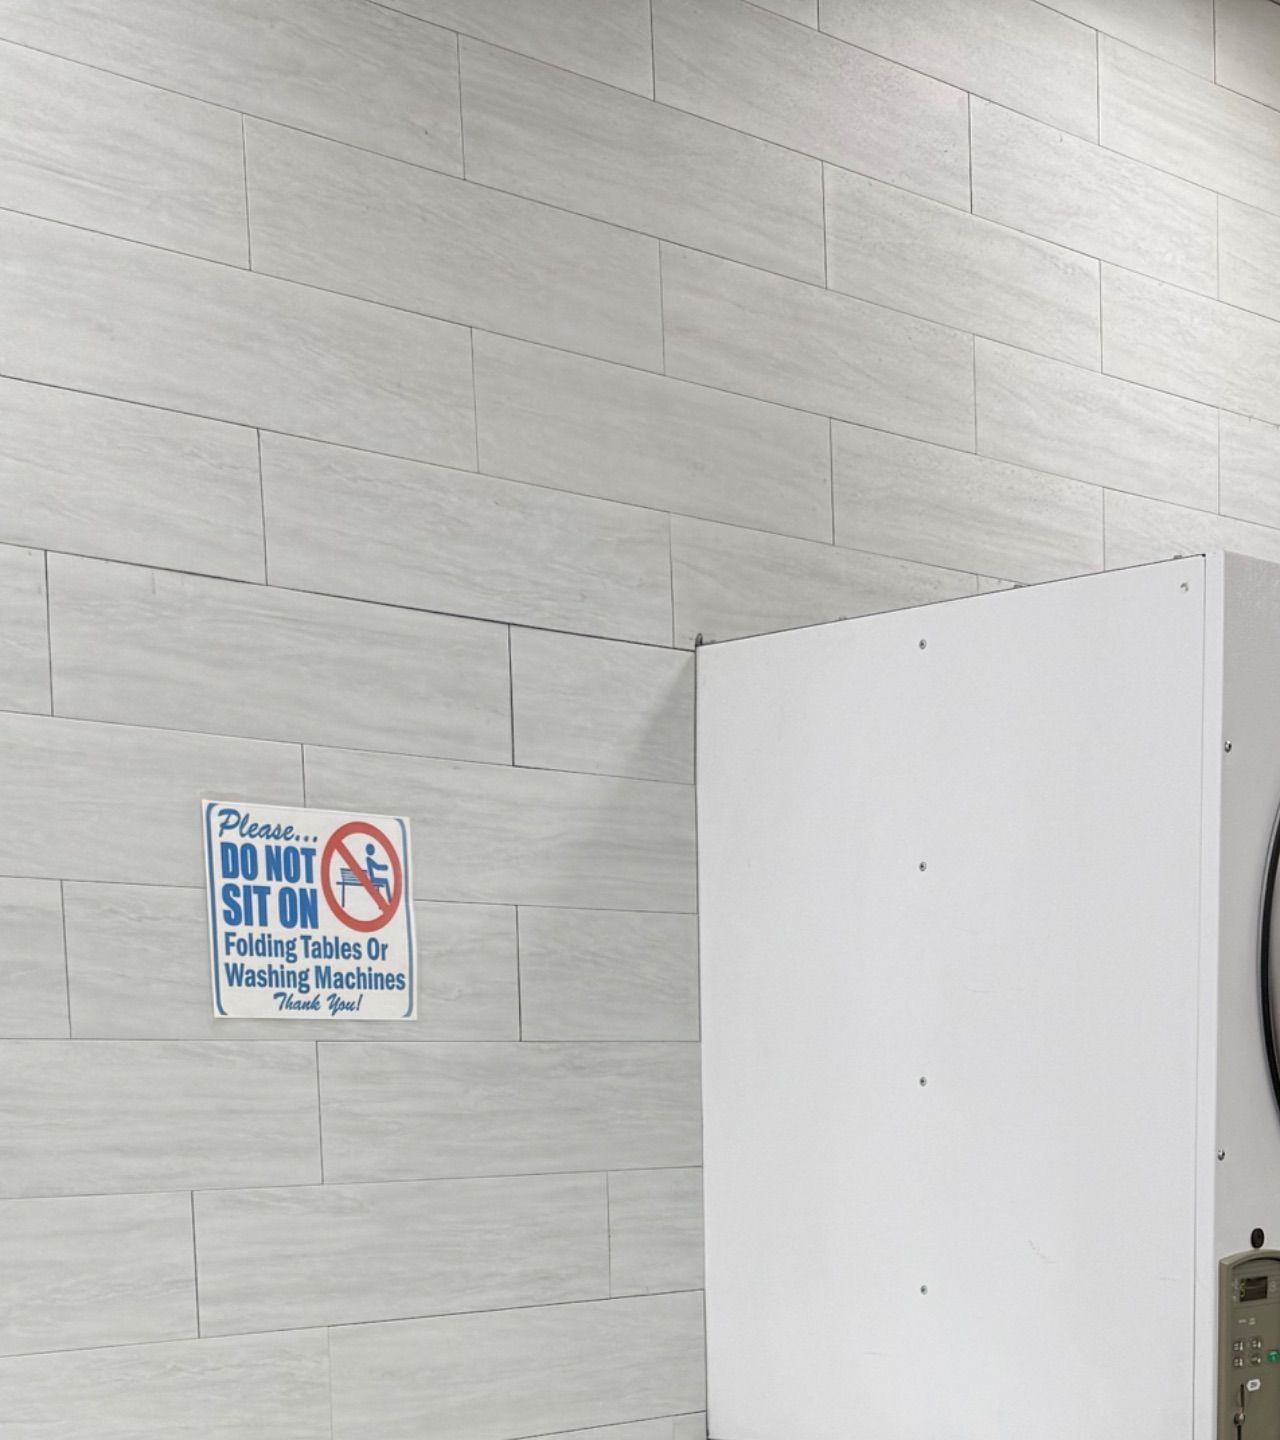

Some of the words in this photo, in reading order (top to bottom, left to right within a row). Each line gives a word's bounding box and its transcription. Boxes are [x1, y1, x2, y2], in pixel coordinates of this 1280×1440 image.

[217, 808, 318, 843] Please...
[220, 842, 258, 881] DO
[265, 845, 316, 884] NOT
[221, 883, 271, 927] SIT
[278, 886, 319, 930] ON
[224, 931, 298, 964] Folding
[300, 935, 363, 960] Tables
[366, 937, 388, 961] Or
[224, 962, 310, 994] Washing
[314, 965, 406, 991] Machines
[273, 992, 321, 1012] Thank
[326, 993, 363, 1016] You!
